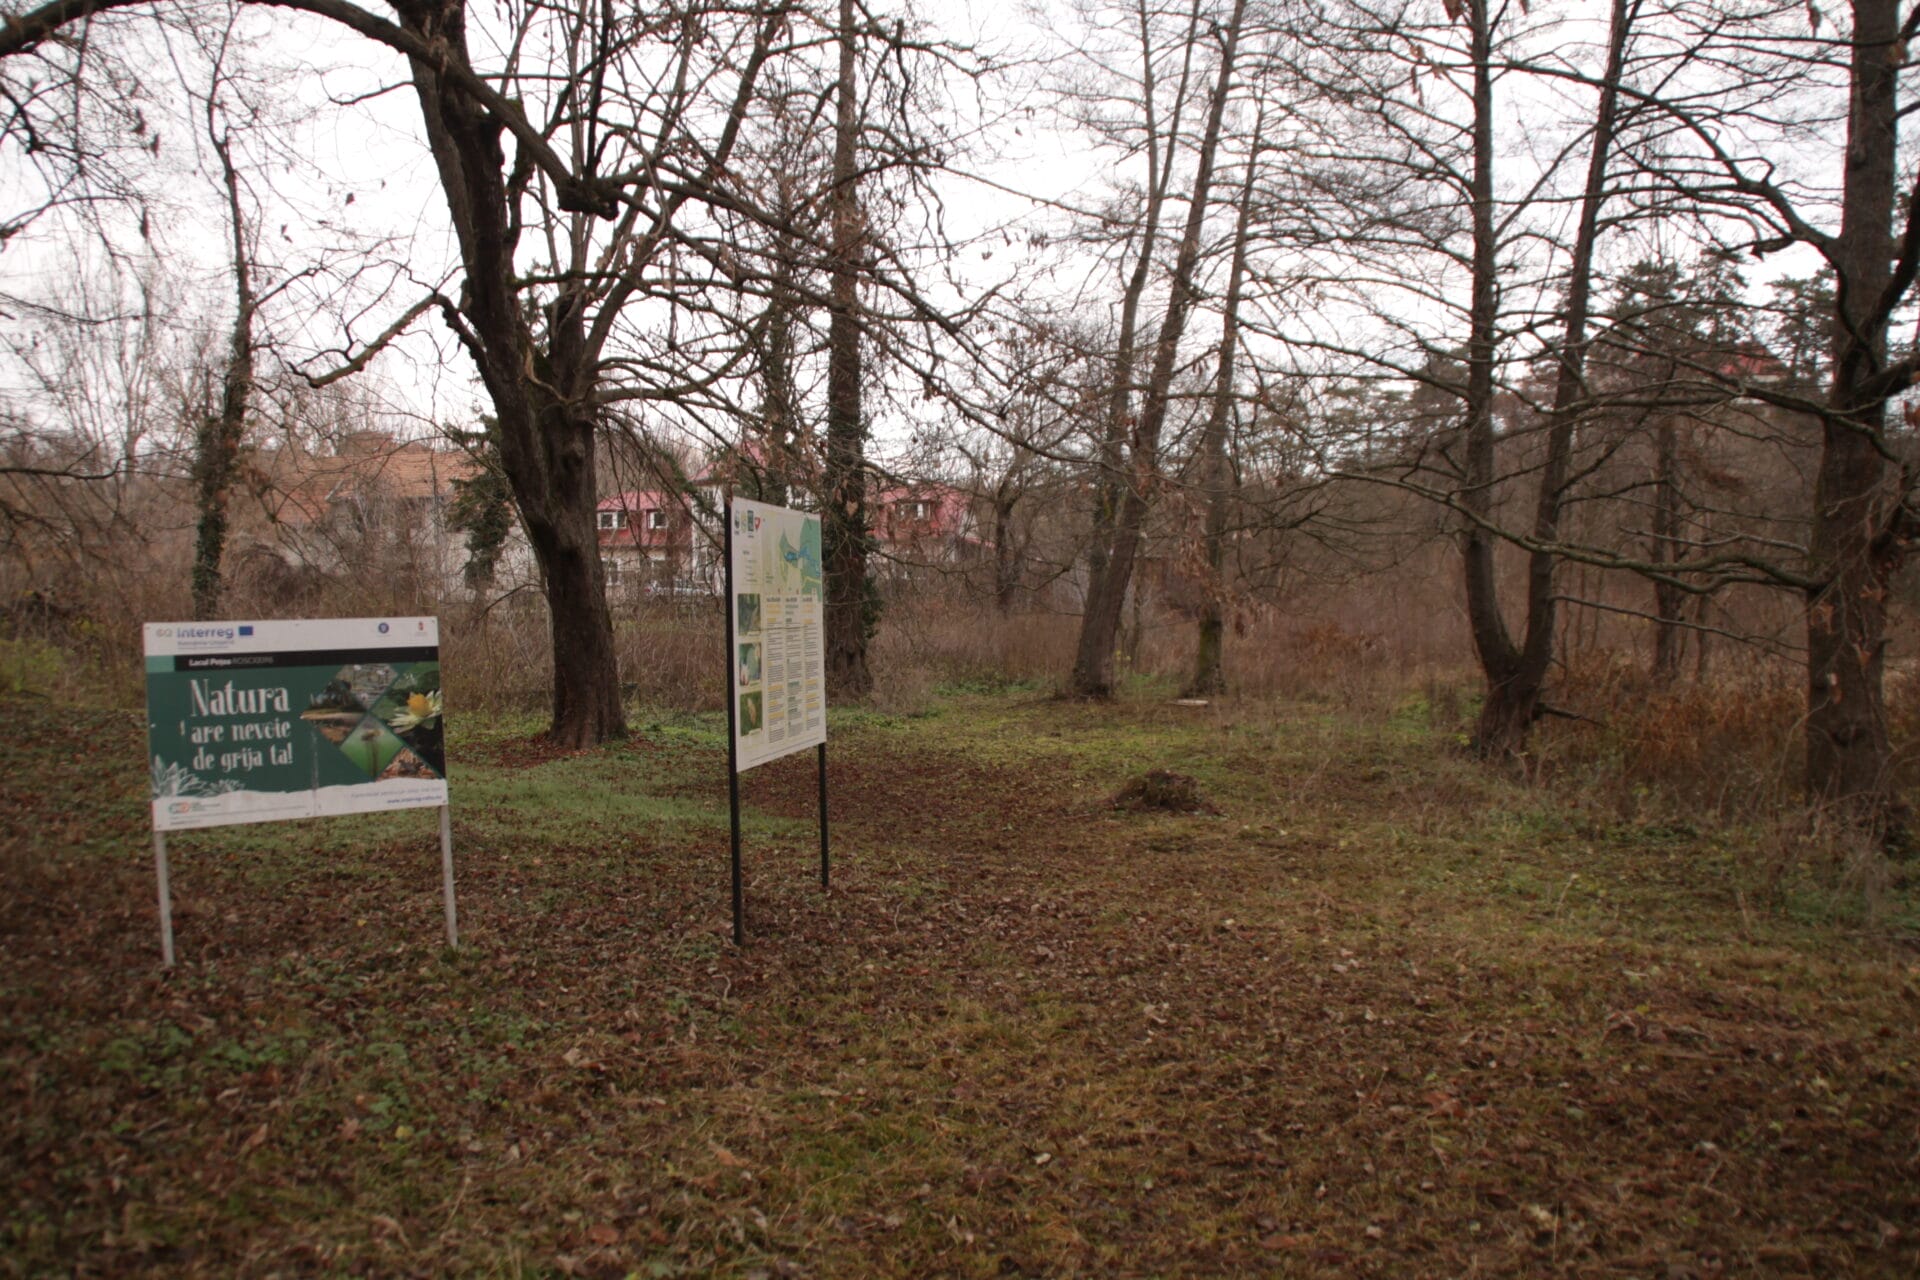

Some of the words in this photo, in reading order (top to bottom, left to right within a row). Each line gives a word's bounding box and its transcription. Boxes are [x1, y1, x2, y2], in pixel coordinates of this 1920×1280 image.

[190, 678, 290, 717] Natura
[191, 723, 224, 744] are
[231, 717, 291, 741] nevoie
[192, 745, 215, 770] de
[220, 746, 264, 773] grija
[269, 741, 293, 766] ta!
